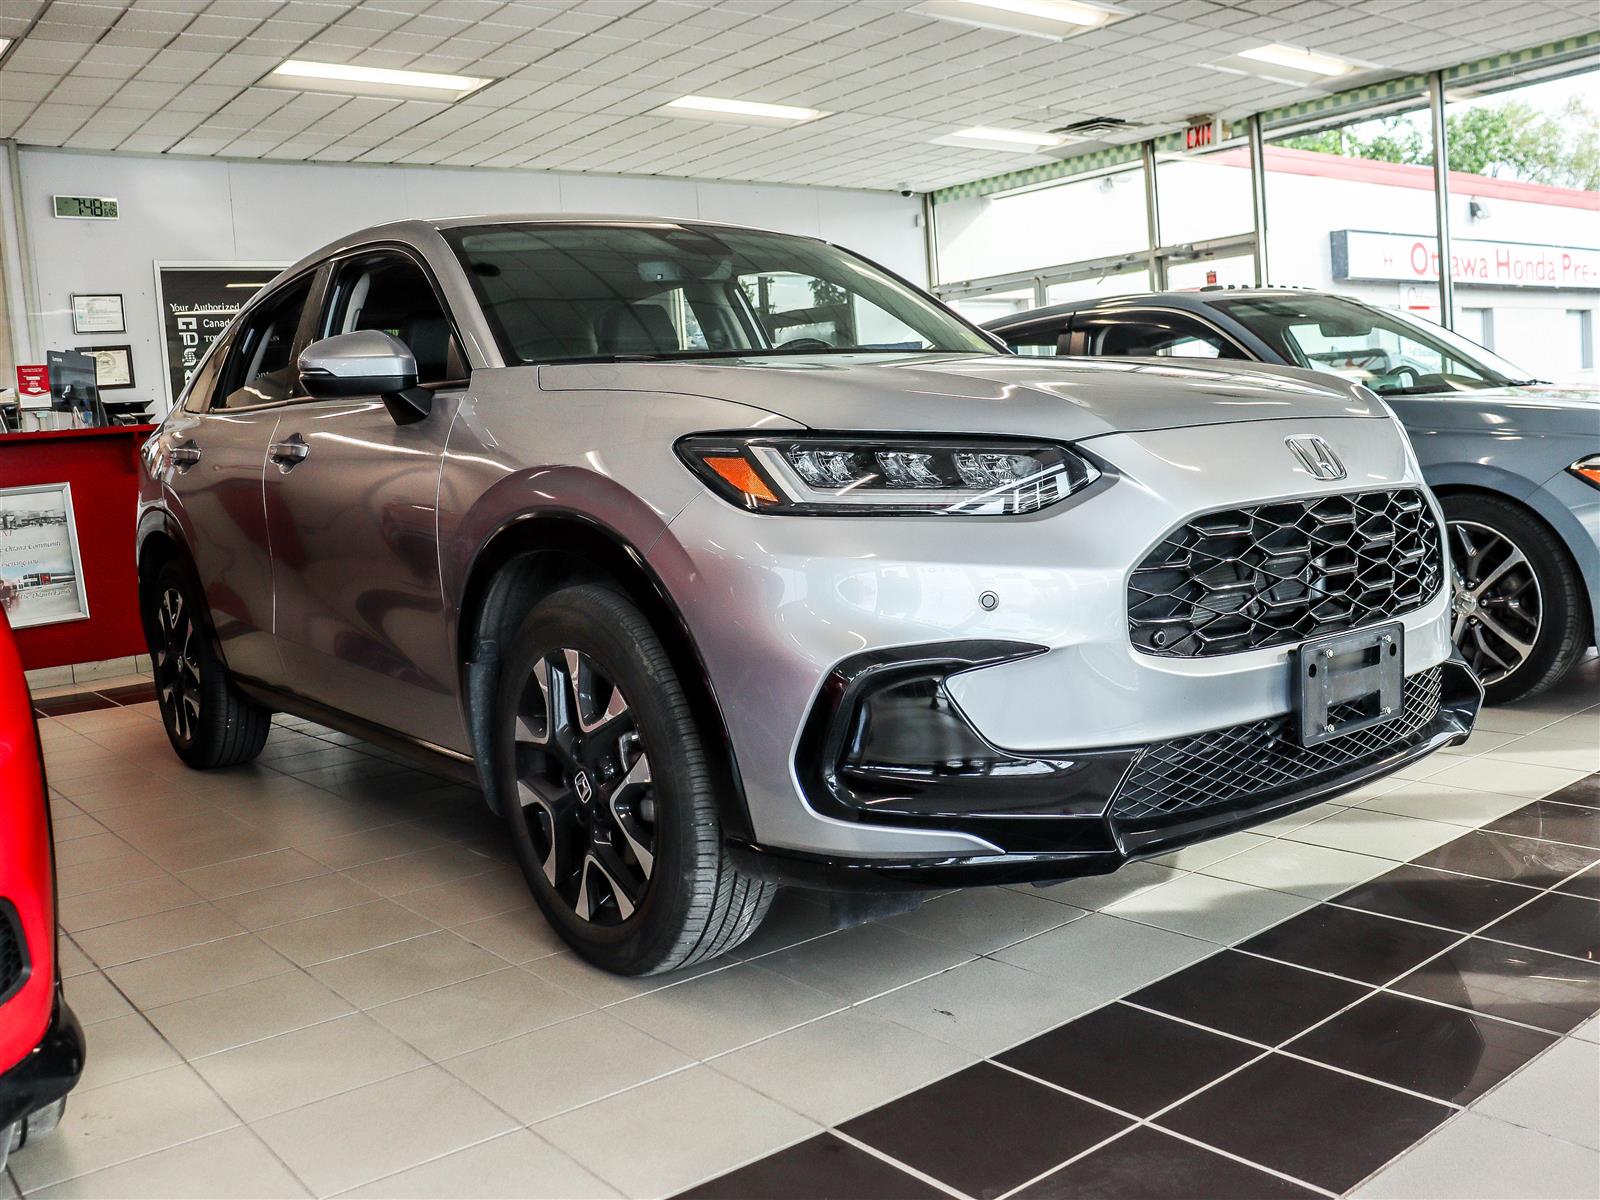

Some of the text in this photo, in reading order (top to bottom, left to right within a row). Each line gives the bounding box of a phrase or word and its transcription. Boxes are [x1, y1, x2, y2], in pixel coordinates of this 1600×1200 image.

[1187, 122, 1212, 149] EXIT
[1410, 242, 1489, 279] Otawa
[1495, 248, 1556, 281] Honda
[169, 302, 240, 313] Your Authorized
